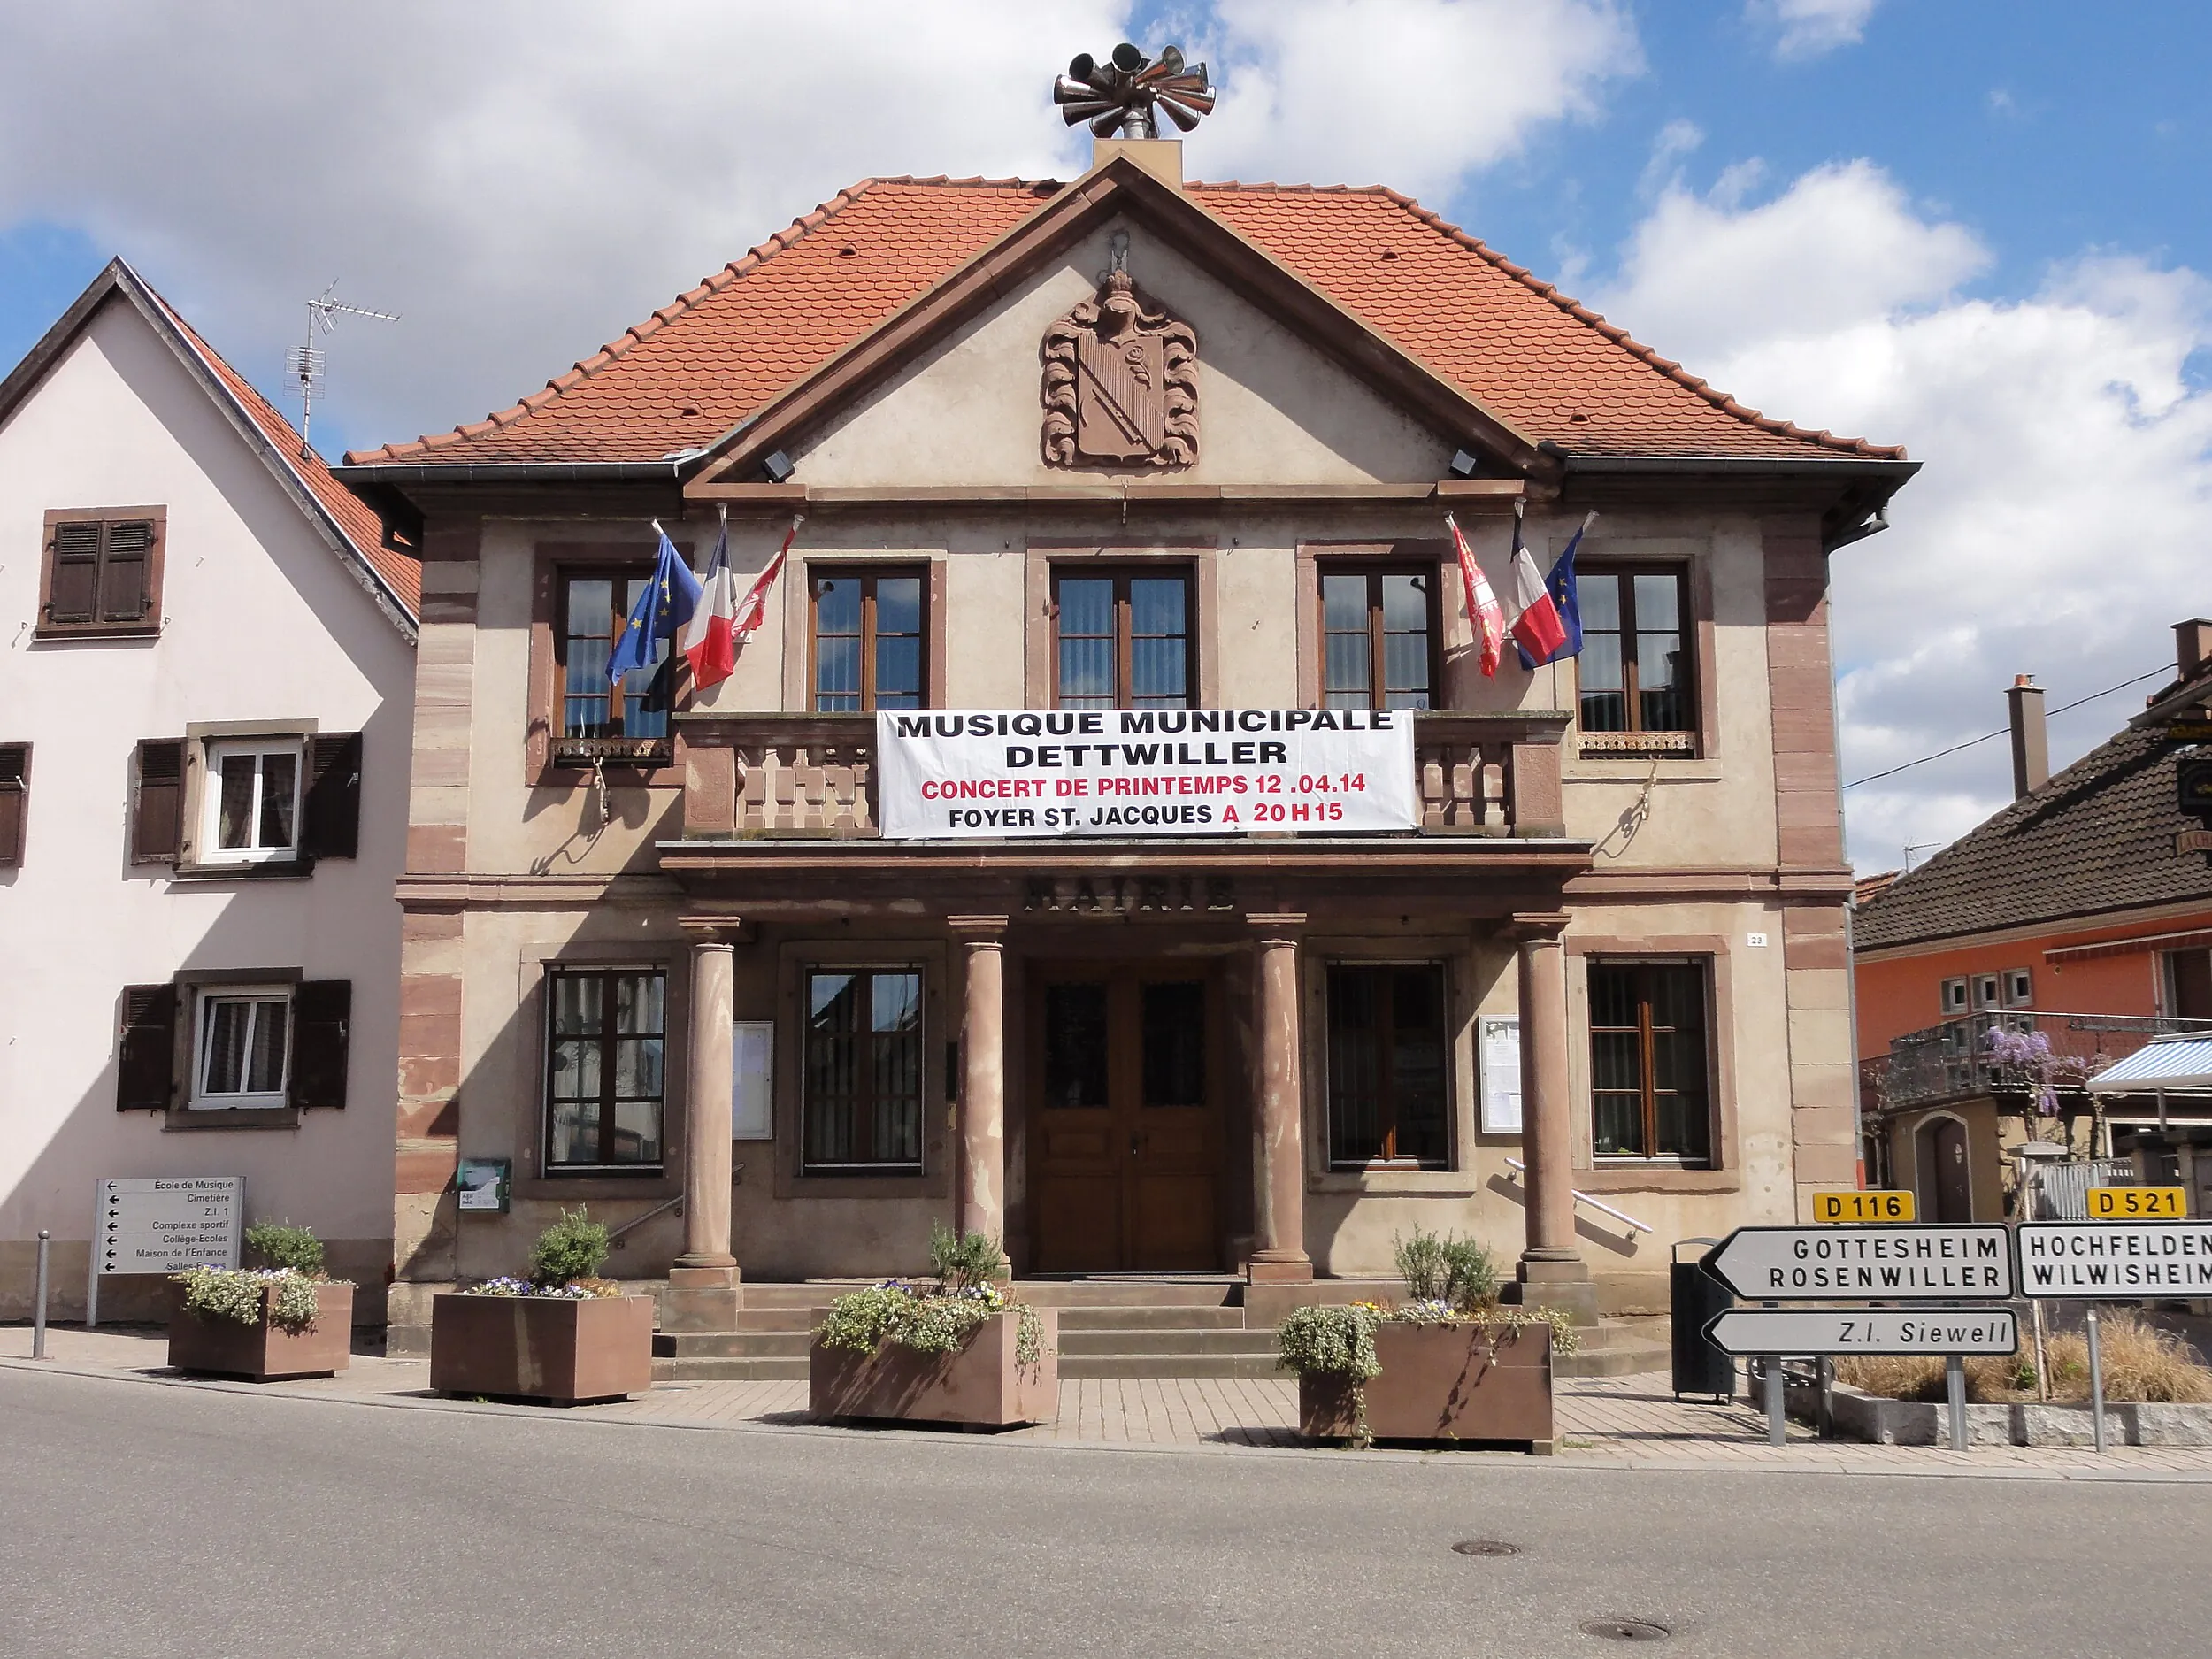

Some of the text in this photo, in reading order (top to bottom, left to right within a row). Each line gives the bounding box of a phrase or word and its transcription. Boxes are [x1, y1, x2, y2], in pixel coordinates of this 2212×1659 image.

[897, 710, 1394, 738] MUSIQUE MUNICIPALE
[1006, 741, 1287, 768] DETTWILLER
[921, 780, 1047, 800] CONCERT
[1056, 778, 1089, 797] DE
[1098, 775, 1248, 796] PRINTEMPS
[949, 808, 1035, 828] FOYER
[1044, 807, 1081, 826] ST.
[1089, 804, 1212, 826] JACQUES
[1222, 804, 1240, 823] A
[1024, 874, 1235, 911] MAIRIE
[196, 1180, 234, 1190] Musique
[187, 1194, 230, 1202] Cimetière
[152, 1220, 229, 1231] Complexe sportif
[135, 1248, 227, 1257] Maison de l'Enfance
[1793, 1237, 1998, 1260] GOTTESHEIM
[2031, 1235, 2212, 1256] HOCHFELDEN
[1770, 1266, 2000, 1288] ROSENWILLER
[2033, 1263, 2212, 1286] WILWISHEIM
[1839, 1322, 2007, 1343] Z.I. Siewell
